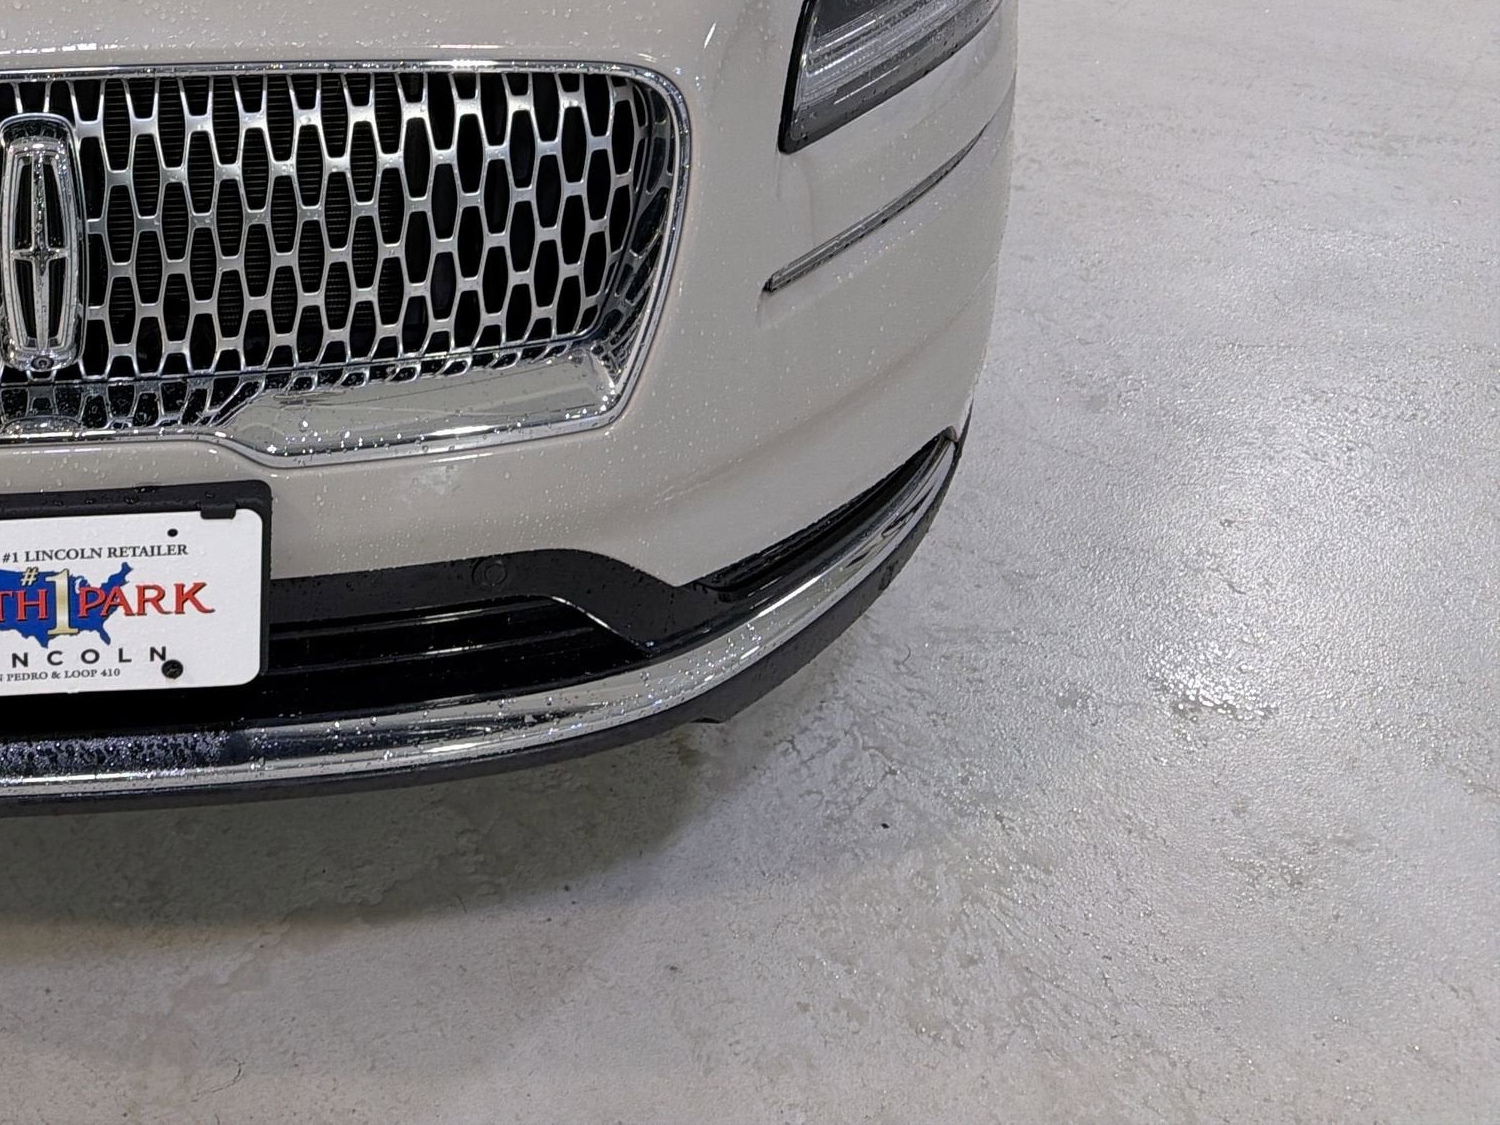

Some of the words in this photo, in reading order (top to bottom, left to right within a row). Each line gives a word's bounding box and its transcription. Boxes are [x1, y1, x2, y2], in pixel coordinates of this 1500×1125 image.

[2, 551, 19, 564] #1
[24, 546, 103, 563] LINCOLN
[107, 543, 189, 560] RETAILER
[78, 581, 216, 621] PARK
[6, 671, 48, 683] PEDRO
[51, 671, 61, 681] &
[64, 668, 98, 680] LOOP
[100, 667, 121, 678] 410
